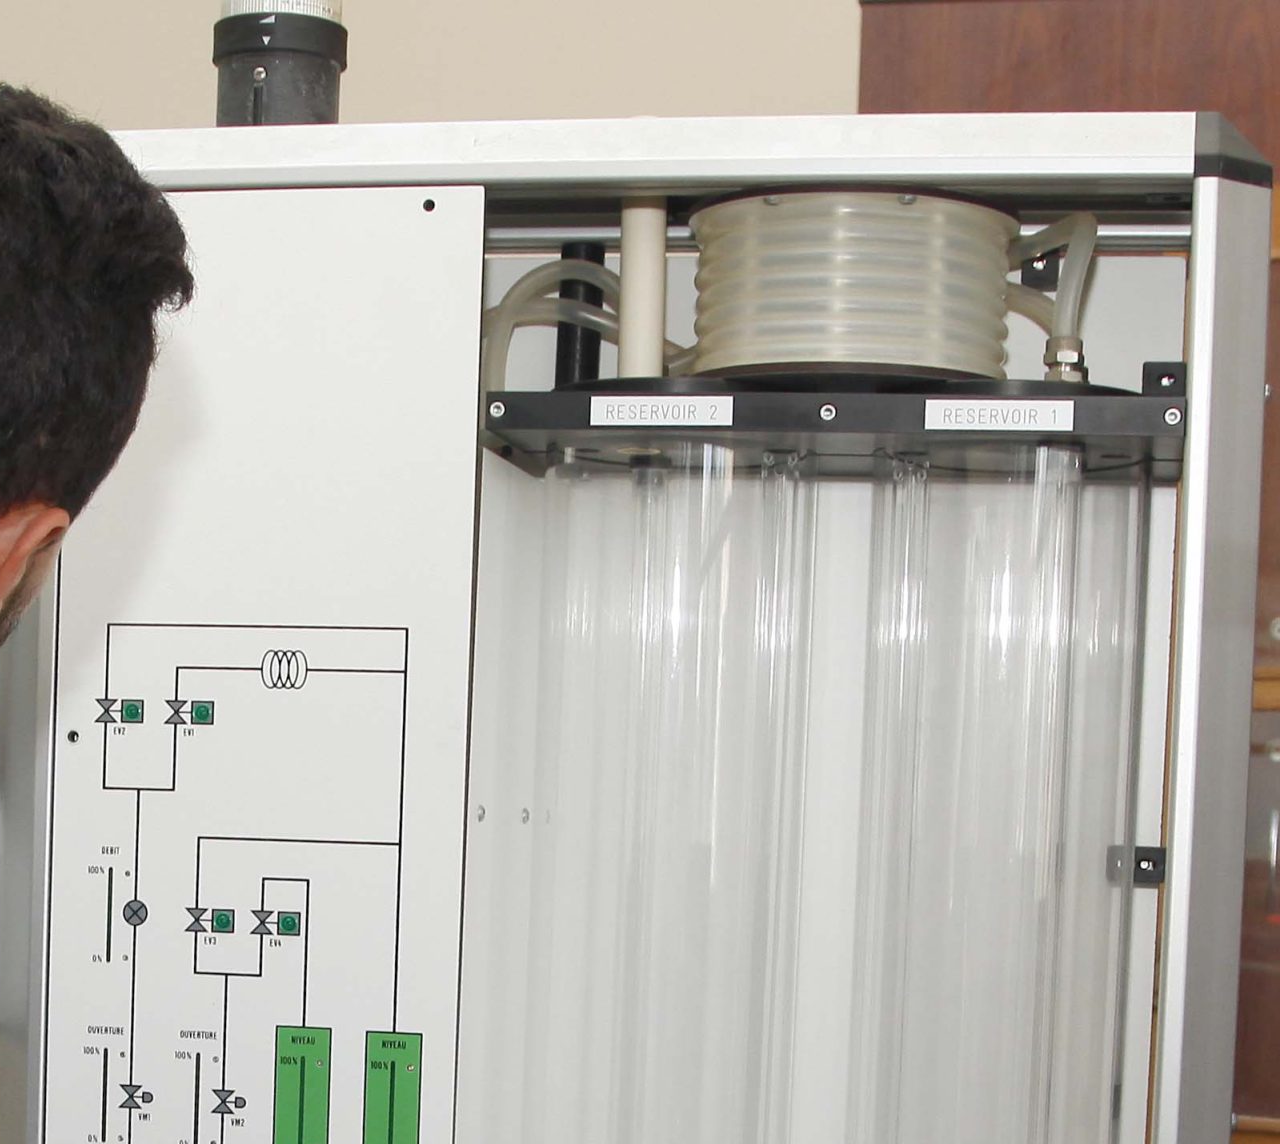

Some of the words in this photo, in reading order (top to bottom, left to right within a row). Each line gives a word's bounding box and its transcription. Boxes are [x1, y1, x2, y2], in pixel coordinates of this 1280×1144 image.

[605, 403, 697, 420] RESERVOIR
[709, 404, 718, 420] 2
[942, 408, 1038, 424] RESERVOIR
[1051, 408, 1057, 424] 1
[113, 727, 126, 735] EV2
[87, 865, 105, 874] 100%
[203, 937, 217, 945] EV3
[269, 939, 282, 948] EV4
[92, 955, 102, 963] 0%
[87, 1025, 124, 1036] OUVERTURE
[180, 1030, 217, 1040] OUVERTURE
[291, 1035, 316, 1045] NIVEAU
[381, 1039, 407, 1050] NIVEAU
[83, 1046, 100, 1055] 100%
[175, 1051, 192, 1060] 100%
[280, 1056, 298, 1065] 100%
[370, 1061, 388, 1070] 100%
[138, 1113, 151, 1121] VM1
[231, 1118, 245, 1127] VM2
[87, 1134, 98, 1143] 0%
